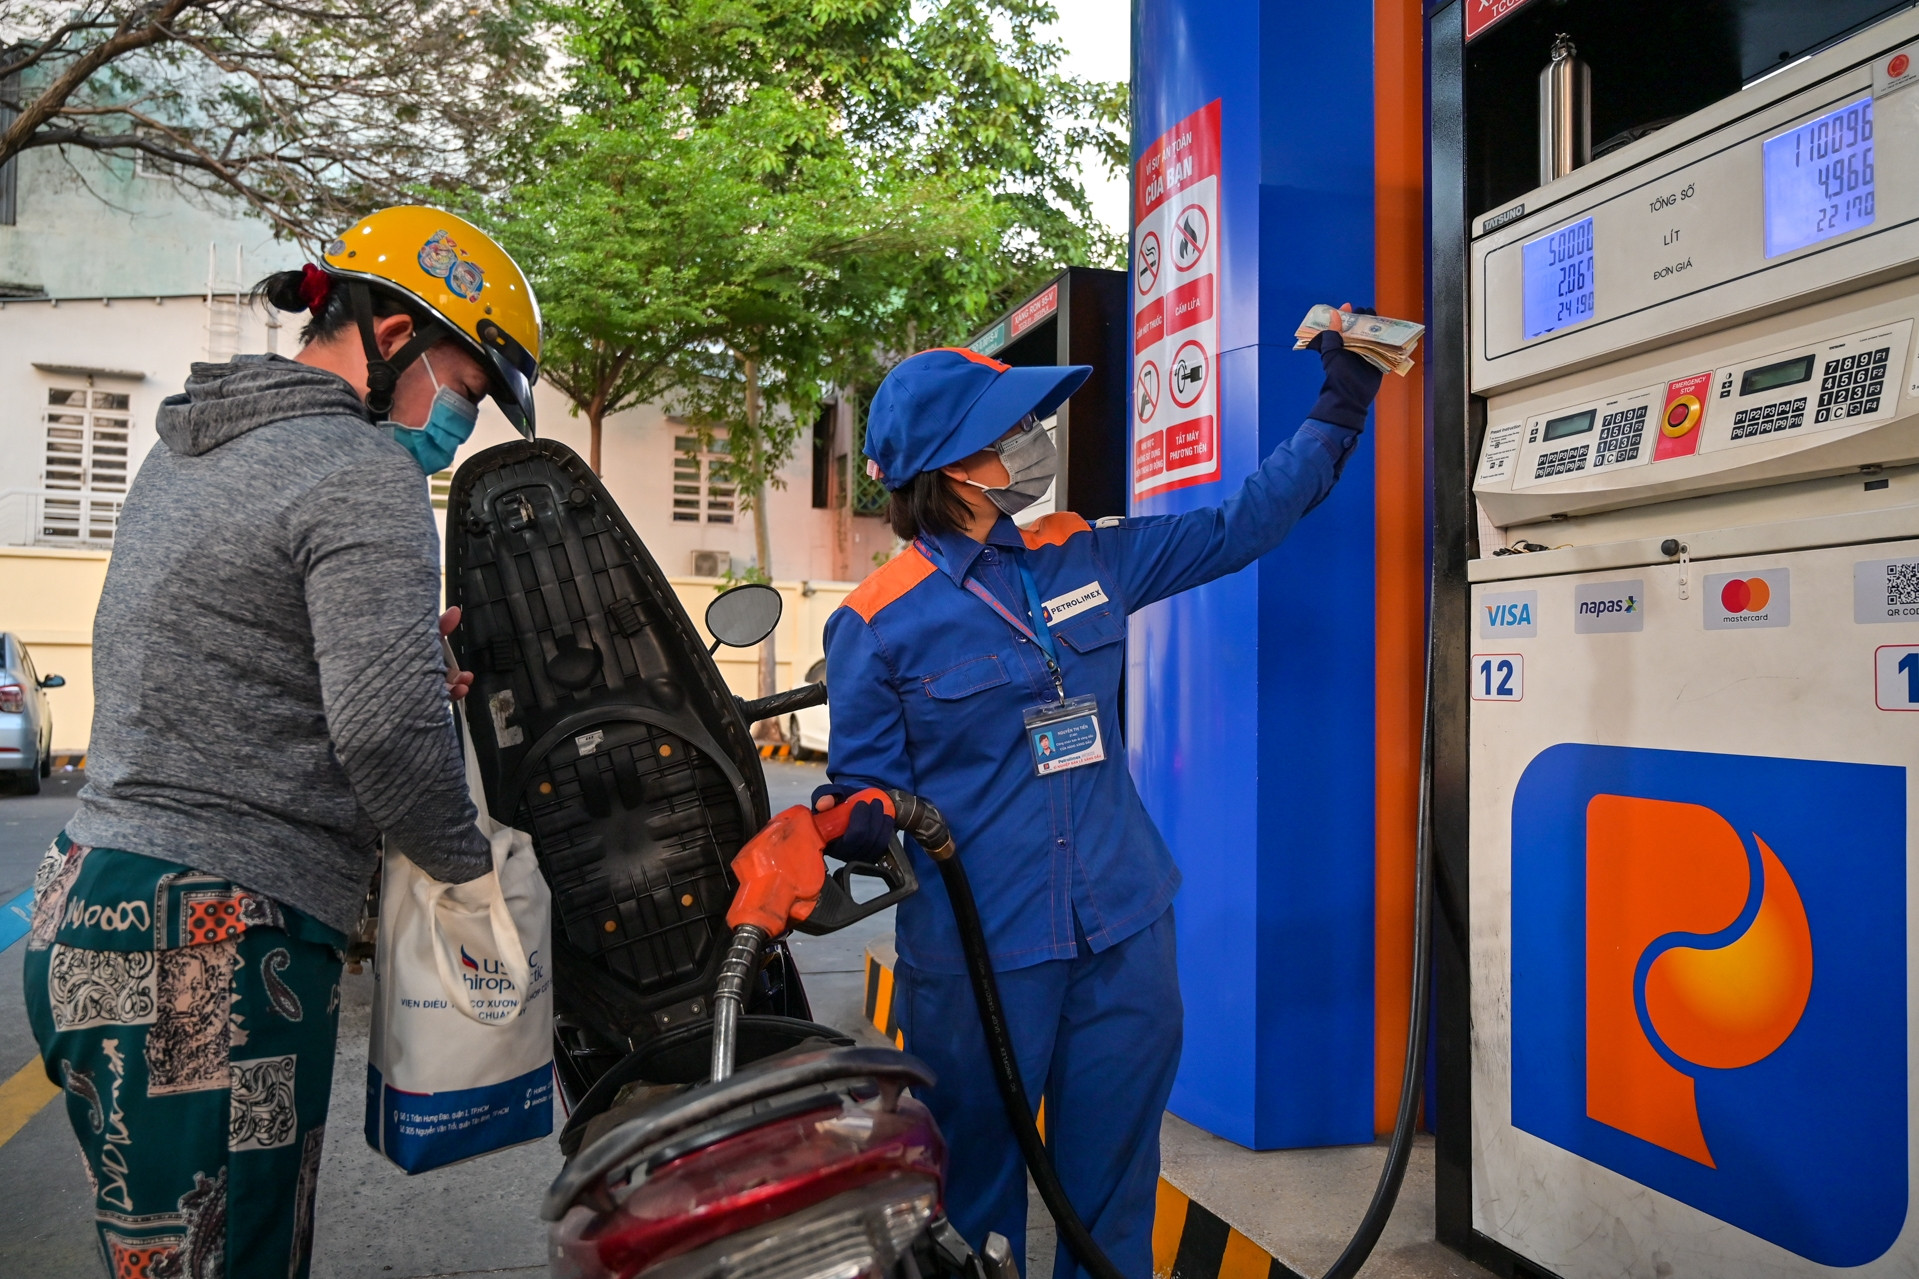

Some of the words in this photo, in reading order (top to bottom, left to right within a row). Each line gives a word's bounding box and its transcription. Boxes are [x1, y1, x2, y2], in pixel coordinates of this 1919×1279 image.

[1796, 104, 1873, 167] 110096
[1162, 146, 1170, 162] AN
[1146, 174, 1164, 206] CỦA
[1167, 156, 1192, 190] BẠN
[1680, 182, 1695, 200] SỐ
[1485, 206, 1522, 230] TATSUNO
[1817, 191, 1874, 232] 22170
[1549, 220, 1592, 266] 50000
[1664, 229, 1680, 246] LÍT
[1676, 257, 1692, 272] GIÁ
[1828, 362, 1836, 373] 7
[1844, 359, 1852, 369] 8
[1860, 355, 1868, 365] 9
[1876, 352, 1886, 360] F1
[1672, 376, 1706, 390] EMERGENCY
[1825, 379, 1832, 389] 4
[1840, 375, 1849, 385] 5
[1857, 371, 1865, 382] 6
[1873, 369, 1883, 377] F2
[1680, 386, 1695, 395] STOP
[1822, 395, 1828, 405] 1
[1837, 391, 1846, 402] 2
[1854, 388, 1862, 398] 3
[1869, 386, 1880, 394] F3
[1605, 416, 1610, 425] 7
[1616, 414, 1621, 422] 8
[1627, 411, 1633, 420] 9
[1736, 414, 1746, 422] P1
[1750, 410, 1761, 419] P2
[1764, 407, 1775, 416] P3
[1779, 404, 1790, 413] P4
[1793, 400, 1805, 409] P5
[1818, 411, 1826, 421] 0
[1834, 407, 1843, 418] C
[1866, 402, 1877, 410] F4
[1612, 428, 1618, 436] 5
[1624, 425, 1630, 433] 6
[1747, 425, 1757, 434] P7
[1761, 422, 1772, 431] P8
[1775, 419, 1787, 428] P9
[1790, 416, 1802, 425] P10
[1176, 432, 1186, 445] TẮT
[1187, 430, 1199, 442] MÁY
[1610, 441, 1616, 449] 2
[1621, 438, 1627, 447] 3
[1170, 447, 1192, 460] PHƯƠNG
[1194, 443, 1206, 455] TIỆN
[1596, 456, 1602, 465] 0
[1607, 454, 1614, 463] C
[1051, 590, 1101, 614] PETROLIMEX
[1579, 600, 1623, 618] napas
[1485, 603, 1531, 626] VISA
[1724, 614, 1768, 623] mastercard
[1480, 660, 1514, 696] 12
[401, 998, 420, 1008] VIỆN
